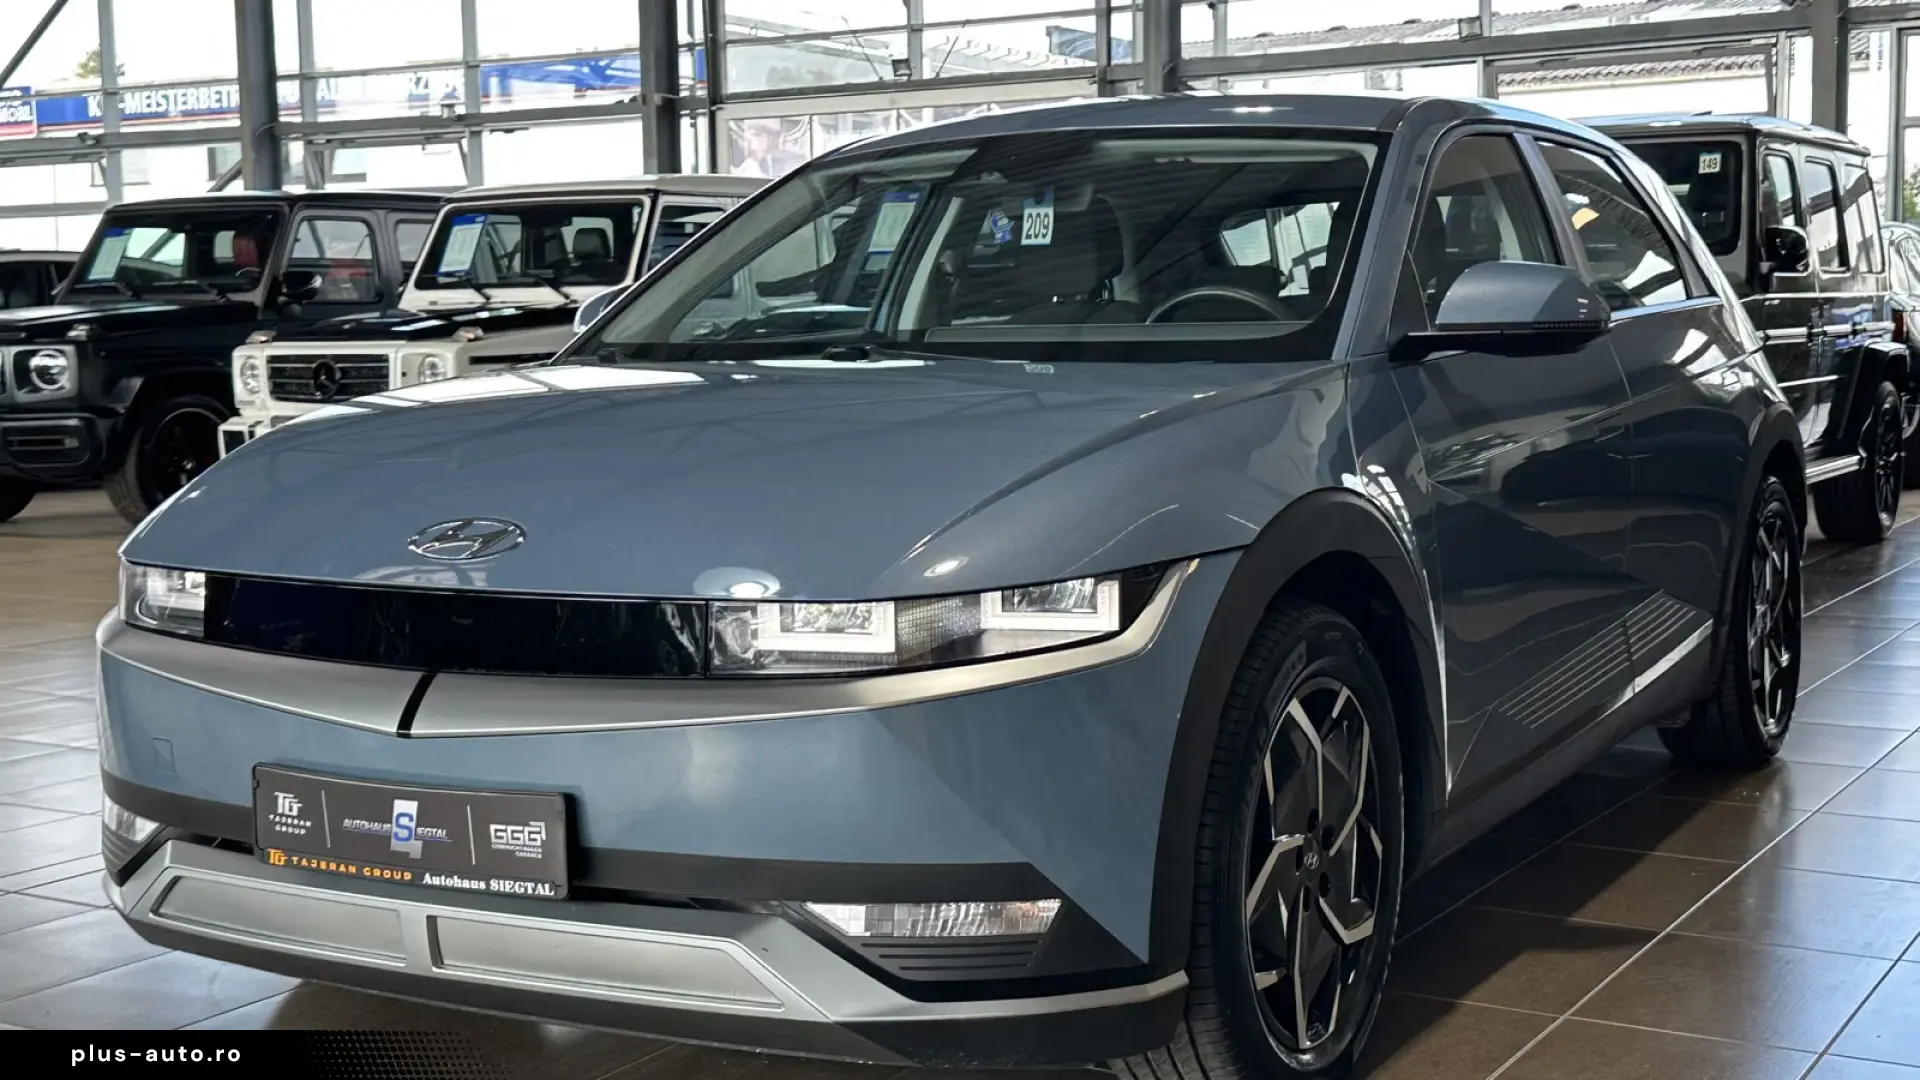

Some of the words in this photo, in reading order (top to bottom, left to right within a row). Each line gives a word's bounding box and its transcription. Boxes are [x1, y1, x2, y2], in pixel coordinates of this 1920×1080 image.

[1702, 157, 1718, 170] 149
[1025, 212, 1050, 240] 209
[274, 824, 307, 835] GROUP
[489, 824, 543, 847] GGG
[362, 867, 413, 881] GROUP
[422, 872, 487, 890] Autohaus
[489, 878, 555, 896] SIEGTAL
